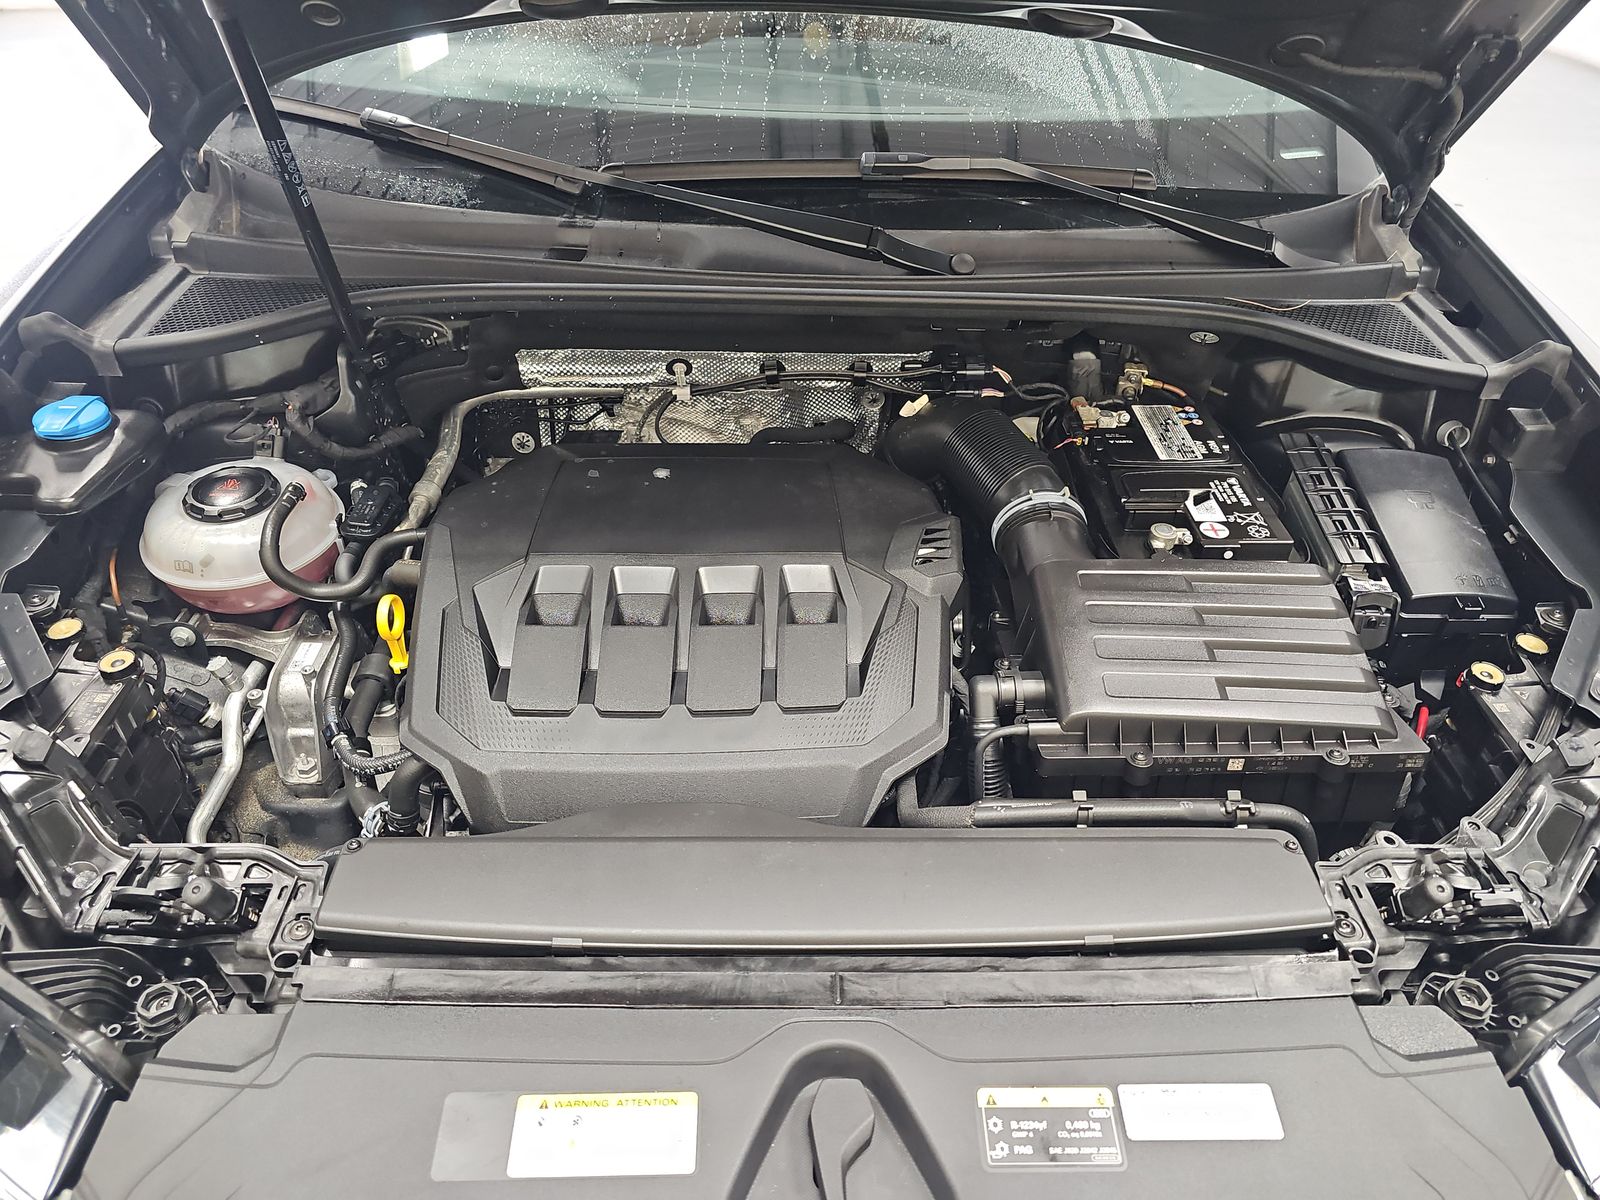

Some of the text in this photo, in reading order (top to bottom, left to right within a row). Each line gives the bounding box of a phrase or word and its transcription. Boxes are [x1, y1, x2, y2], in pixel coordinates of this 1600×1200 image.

[1231, 484, 1253, 507] VARTA
[554, 1098, 678, 1108] WARNING ATTENTION
